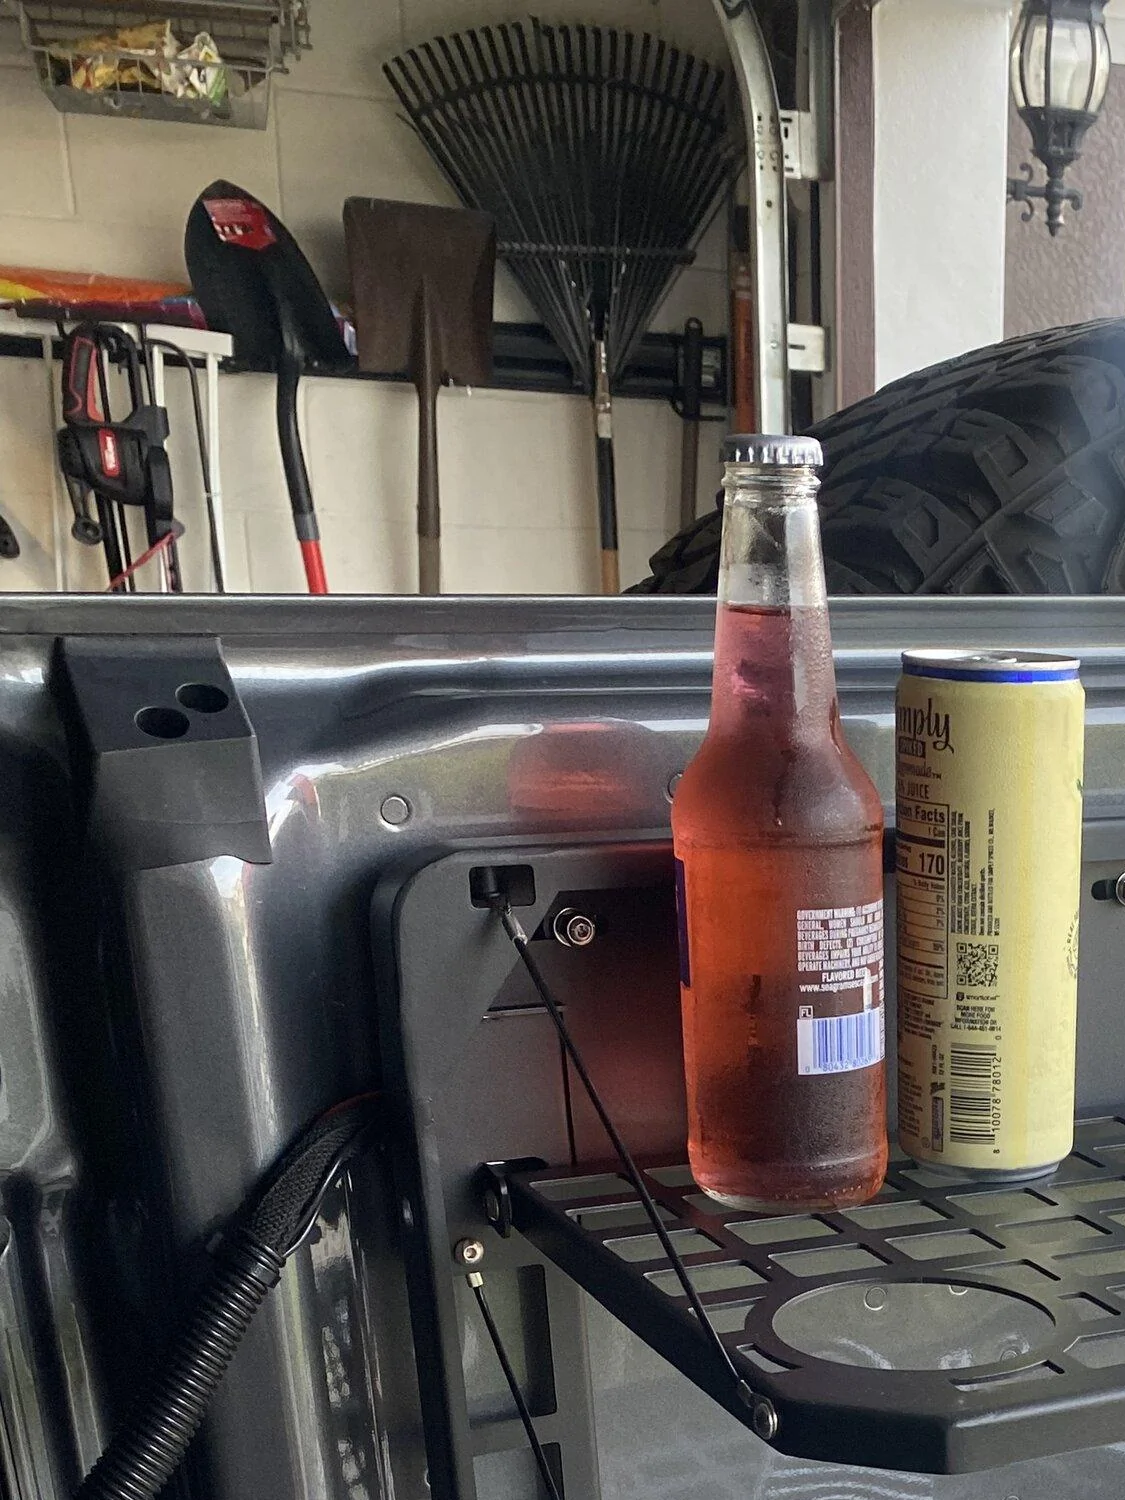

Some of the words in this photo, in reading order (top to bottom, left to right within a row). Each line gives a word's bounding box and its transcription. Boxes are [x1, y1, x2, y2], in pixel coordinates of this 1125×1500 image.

[907, 783, 930, 800] JUICE
[915, 806, 945, 824] Facts
[919, 852, 945, 876] 170
[822, 969, 855, 983] FLAVORED
[801, 1008, 812, 1017] FL
[992, 1057, 1001, 1092] 78012
[992, 1098, 1001, 1132] 10078
